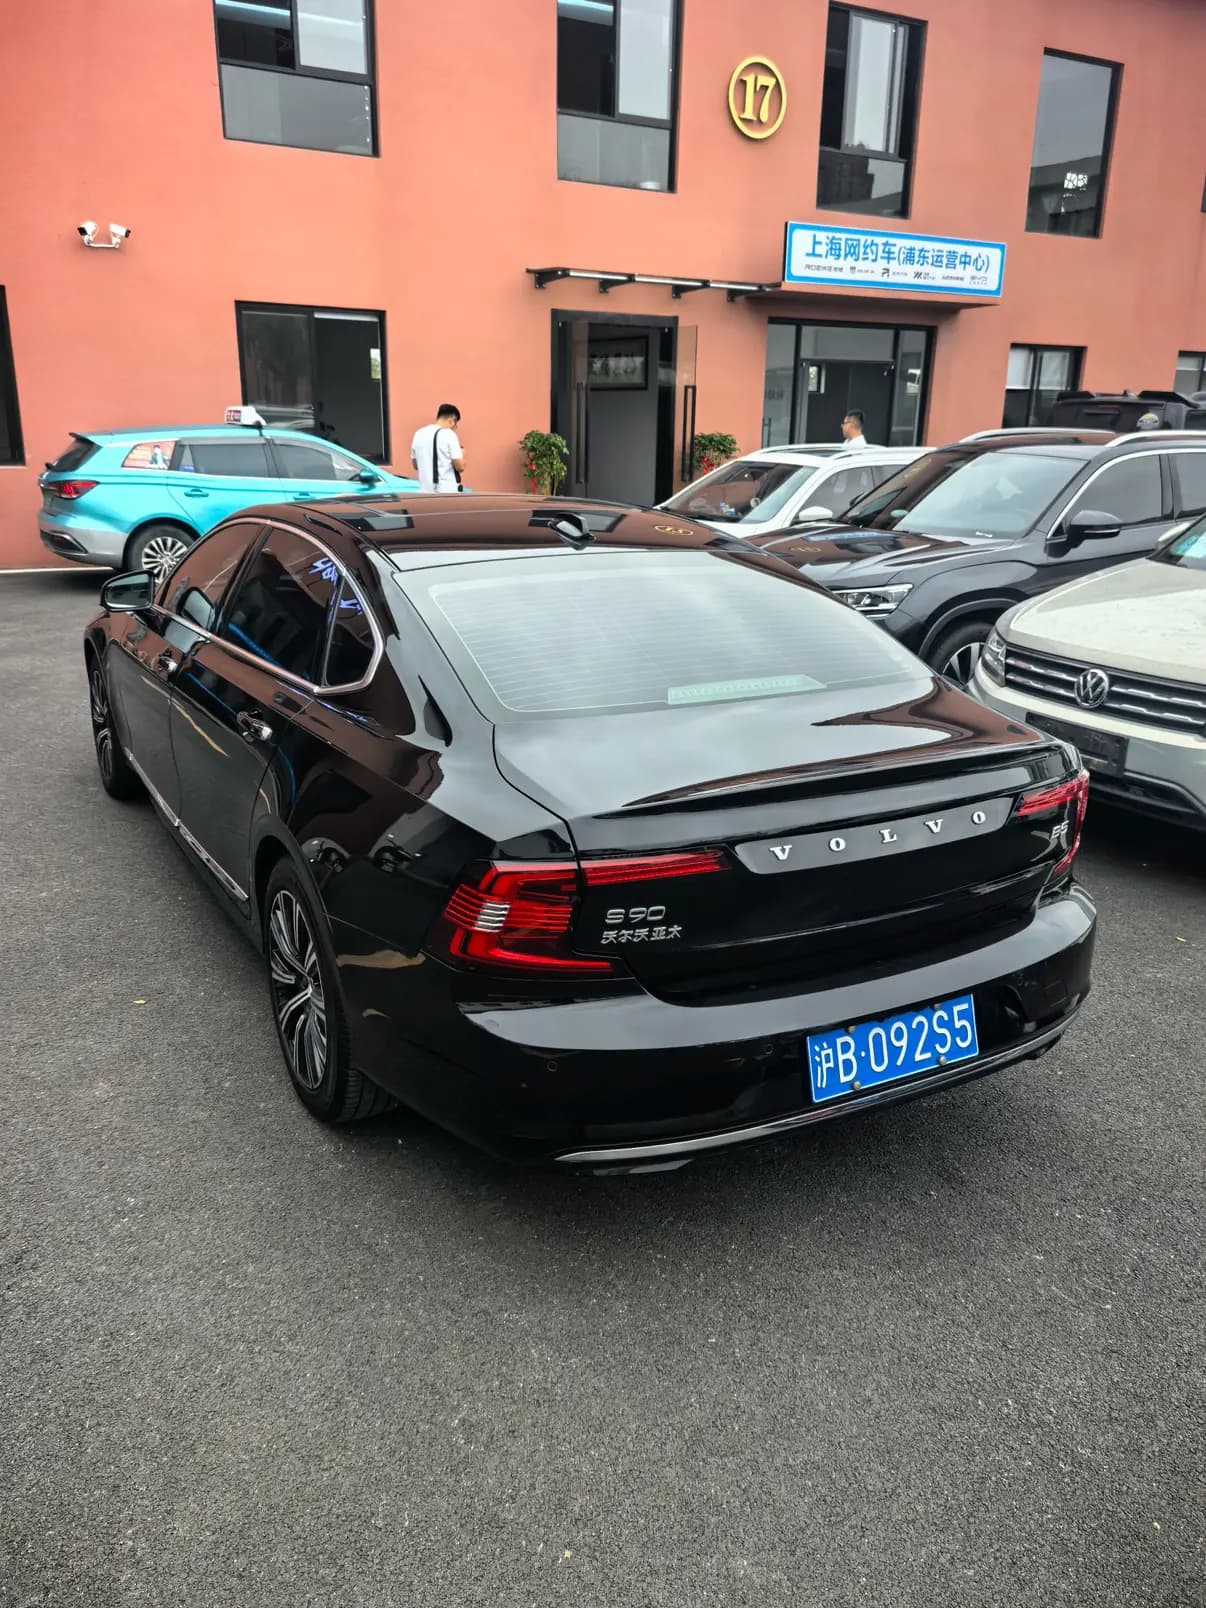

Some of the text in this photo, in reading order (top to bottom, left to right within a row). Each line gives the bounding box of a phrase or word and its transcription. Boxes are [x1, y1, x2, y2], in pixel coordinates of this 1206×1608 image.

[739, 73, 777, 123] 17
[805, 233, 990, 273] 上海网约车(浦东运营中心)
[770, 811, 986, 861] VOLVO
[605, 905, 666, 923] S90
[600, 924, 682, 945] 沃尔沃亚太
